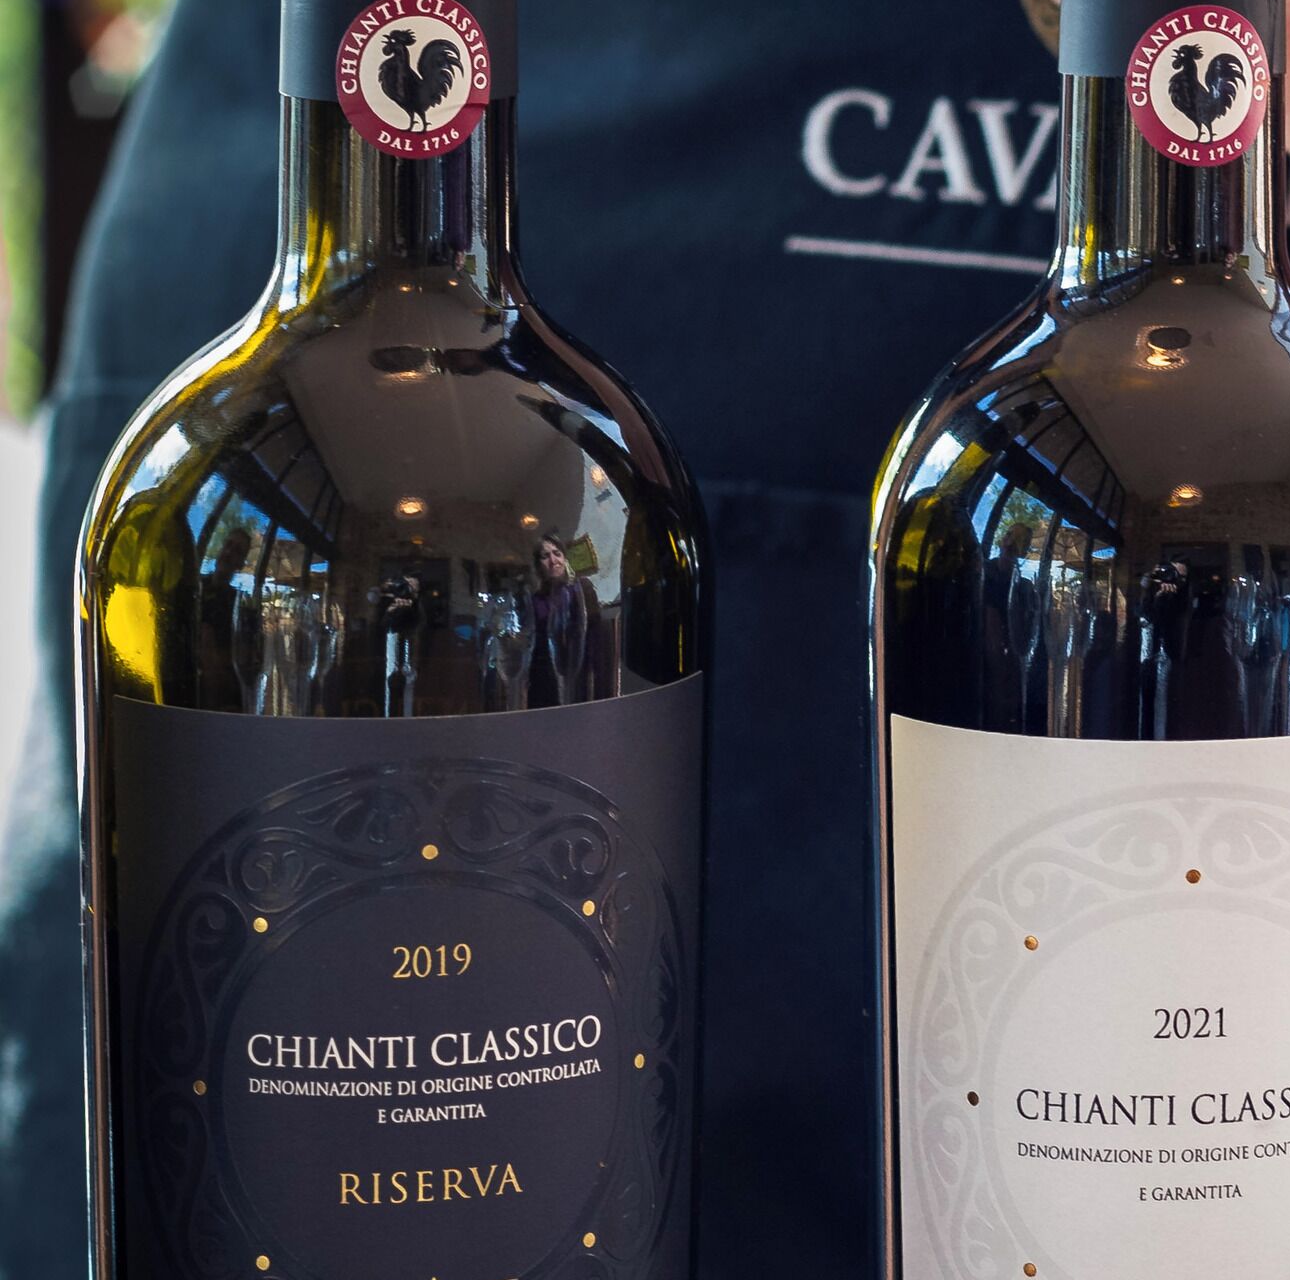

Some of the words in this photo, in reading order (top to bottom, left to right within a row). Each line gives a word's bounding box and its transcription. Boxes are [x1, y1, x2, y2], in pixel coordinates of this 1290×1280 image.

[1131, 14, 1193, 108] CHIANTI
[1203, 12, 1266, 103] CLASSICO
[377, 130, 414, 152] DAL
[422, 128, 461, 152] 1716
[801, 87, 1058, 212] CAV
[1166, 141, 1201, 162] DAL
[1208, 138, 1244, 161] 1716
[392, 943, 473, 980] 2019
[1153, 1006, 1229, 1040] 2021
[246, 1033, 418, 1070] CHIANTI
[430, 1014, 602, 1068] CLASSICO
[248, 1076, 393, 1097] DENOMINAZIONE
[398, 1079, 417, 1096] DI
[421, 1073, 494, 1096] ORIGINE
[496, 1057, 602, 1089] CONTROLLATA
[377, 1108, 388, 1124] E
[390, 1103, 487, 1124] GARANTITA
[1016, 1088, 1177, 1126] CHIANTI
[1016, 1141, 1154, 1164] DENOMINAZIONE
[1158, 1148, 1177, 1164] DI
[1180, 1144, 1250, 1164] ORIGINE
[338, 1162, 524, 1205] RISERVA
[1138, 1186, 1148, 1201] E
[1151, 1183, 1243, 1202] GARANTITA
